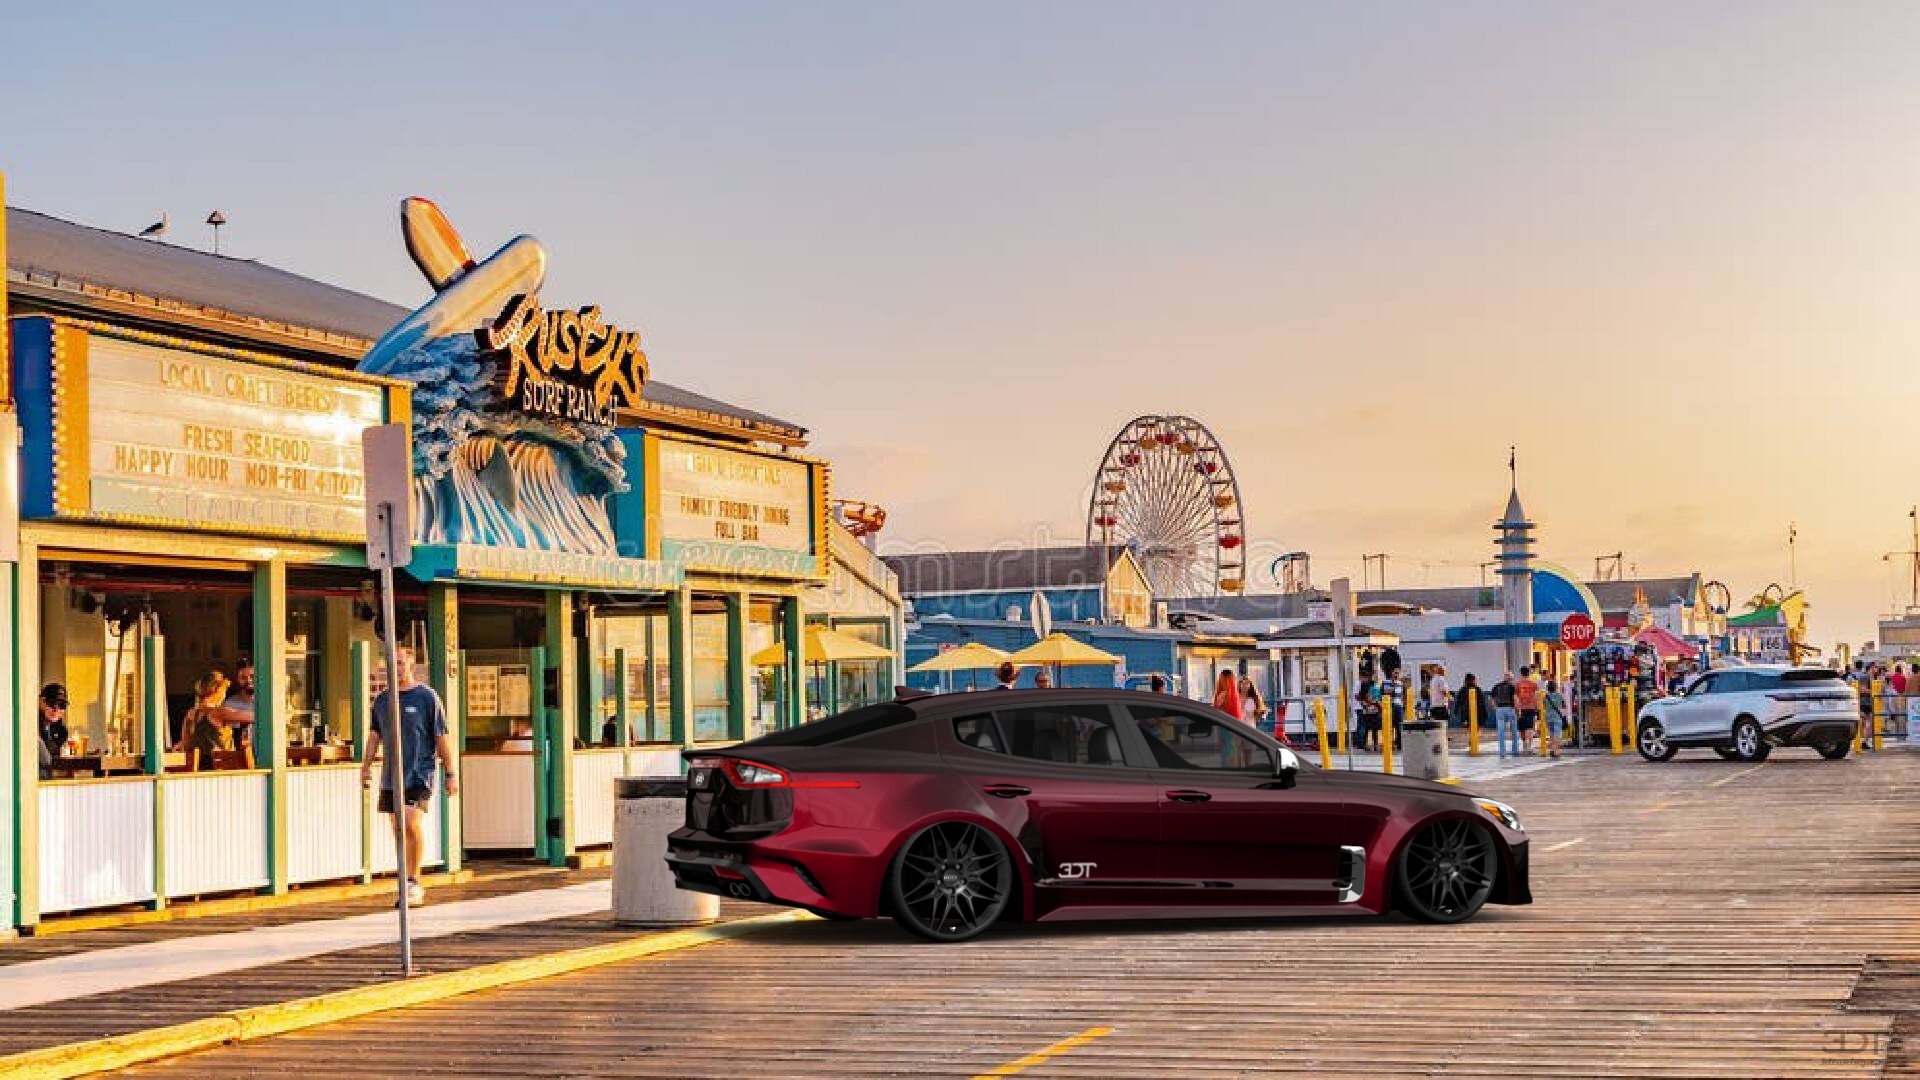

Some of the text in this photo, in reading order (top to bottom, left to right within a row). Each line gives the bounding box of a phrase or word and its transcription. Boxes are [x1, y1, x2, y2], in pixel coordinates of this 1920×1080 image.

[161, 359, 330, 411] LOCAL CRAFT BEERS
[523, 377, 564, 416] SURF
[184, 423, 309, 462] FRESH SEAFOOD
[115, 445, 172, 475] HAPPY
[187, 455, 229, 481] HOUR
[245, 463, 307, 491] MON-FRI
[715, 520, 735, 539] FULL
[1563, 624, 1594, 640] STOP
[1058, 862, 1097, 878] 3DT
